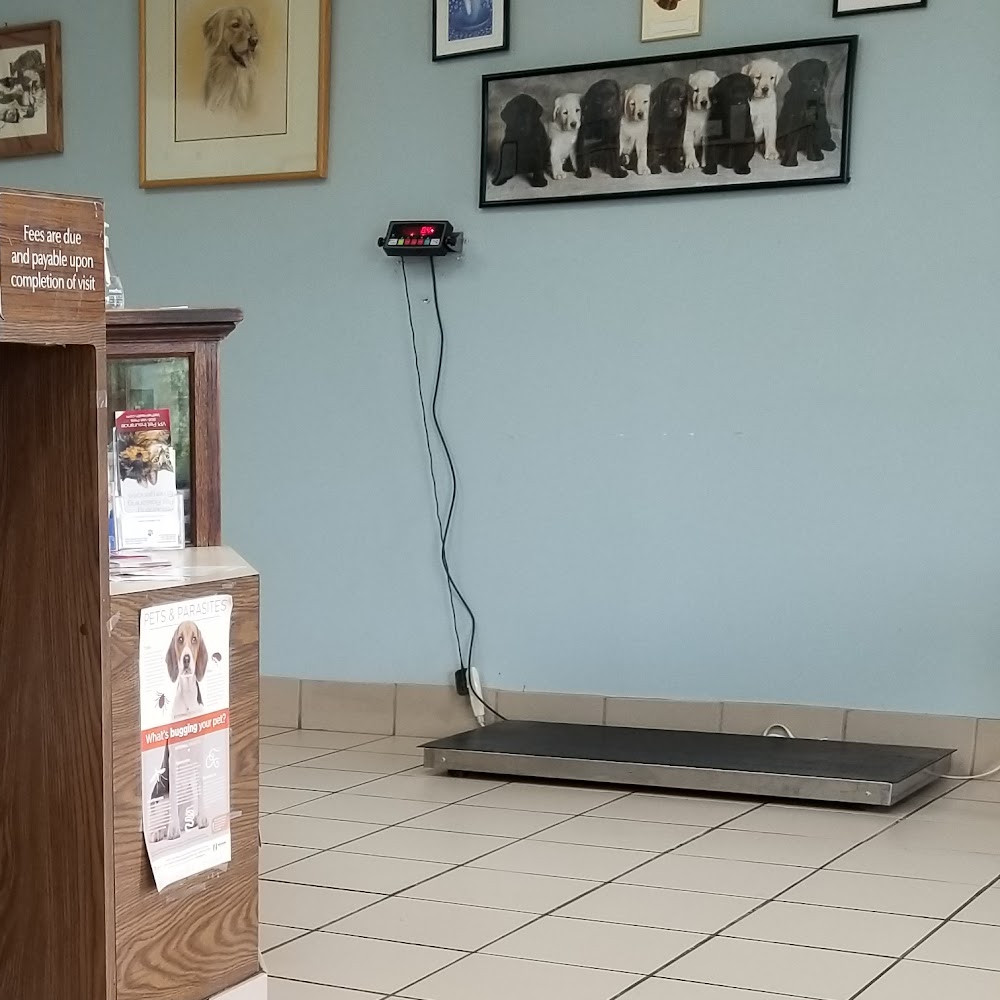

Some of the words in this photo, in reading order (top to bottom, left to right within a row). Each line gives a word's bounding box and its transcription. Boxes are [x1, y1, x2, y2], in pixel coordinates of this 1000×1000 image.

[23, 224, 45, 243] Fees
[46, 231, 61, 244] are
[63, 228, 82, 245] due
[11, 248, 30, 265] and
[31, 249, 67, 270] payable
[69, 256, 94, 272] upon
[10, 272, 65, 292] completion
[66, 274, 77, 290] of
[77, 275, 96, 291] visit
[144, 610, 166, 625] PETS
[169, 608, 175, 621] &
[178, 599, 227, 618] PARASITES
[145, 730, 169, 744] What's
[170, 724, 197, 738] bugging
[199, 719, 212, 732] your
[212, 713, 226, 727] pet?
